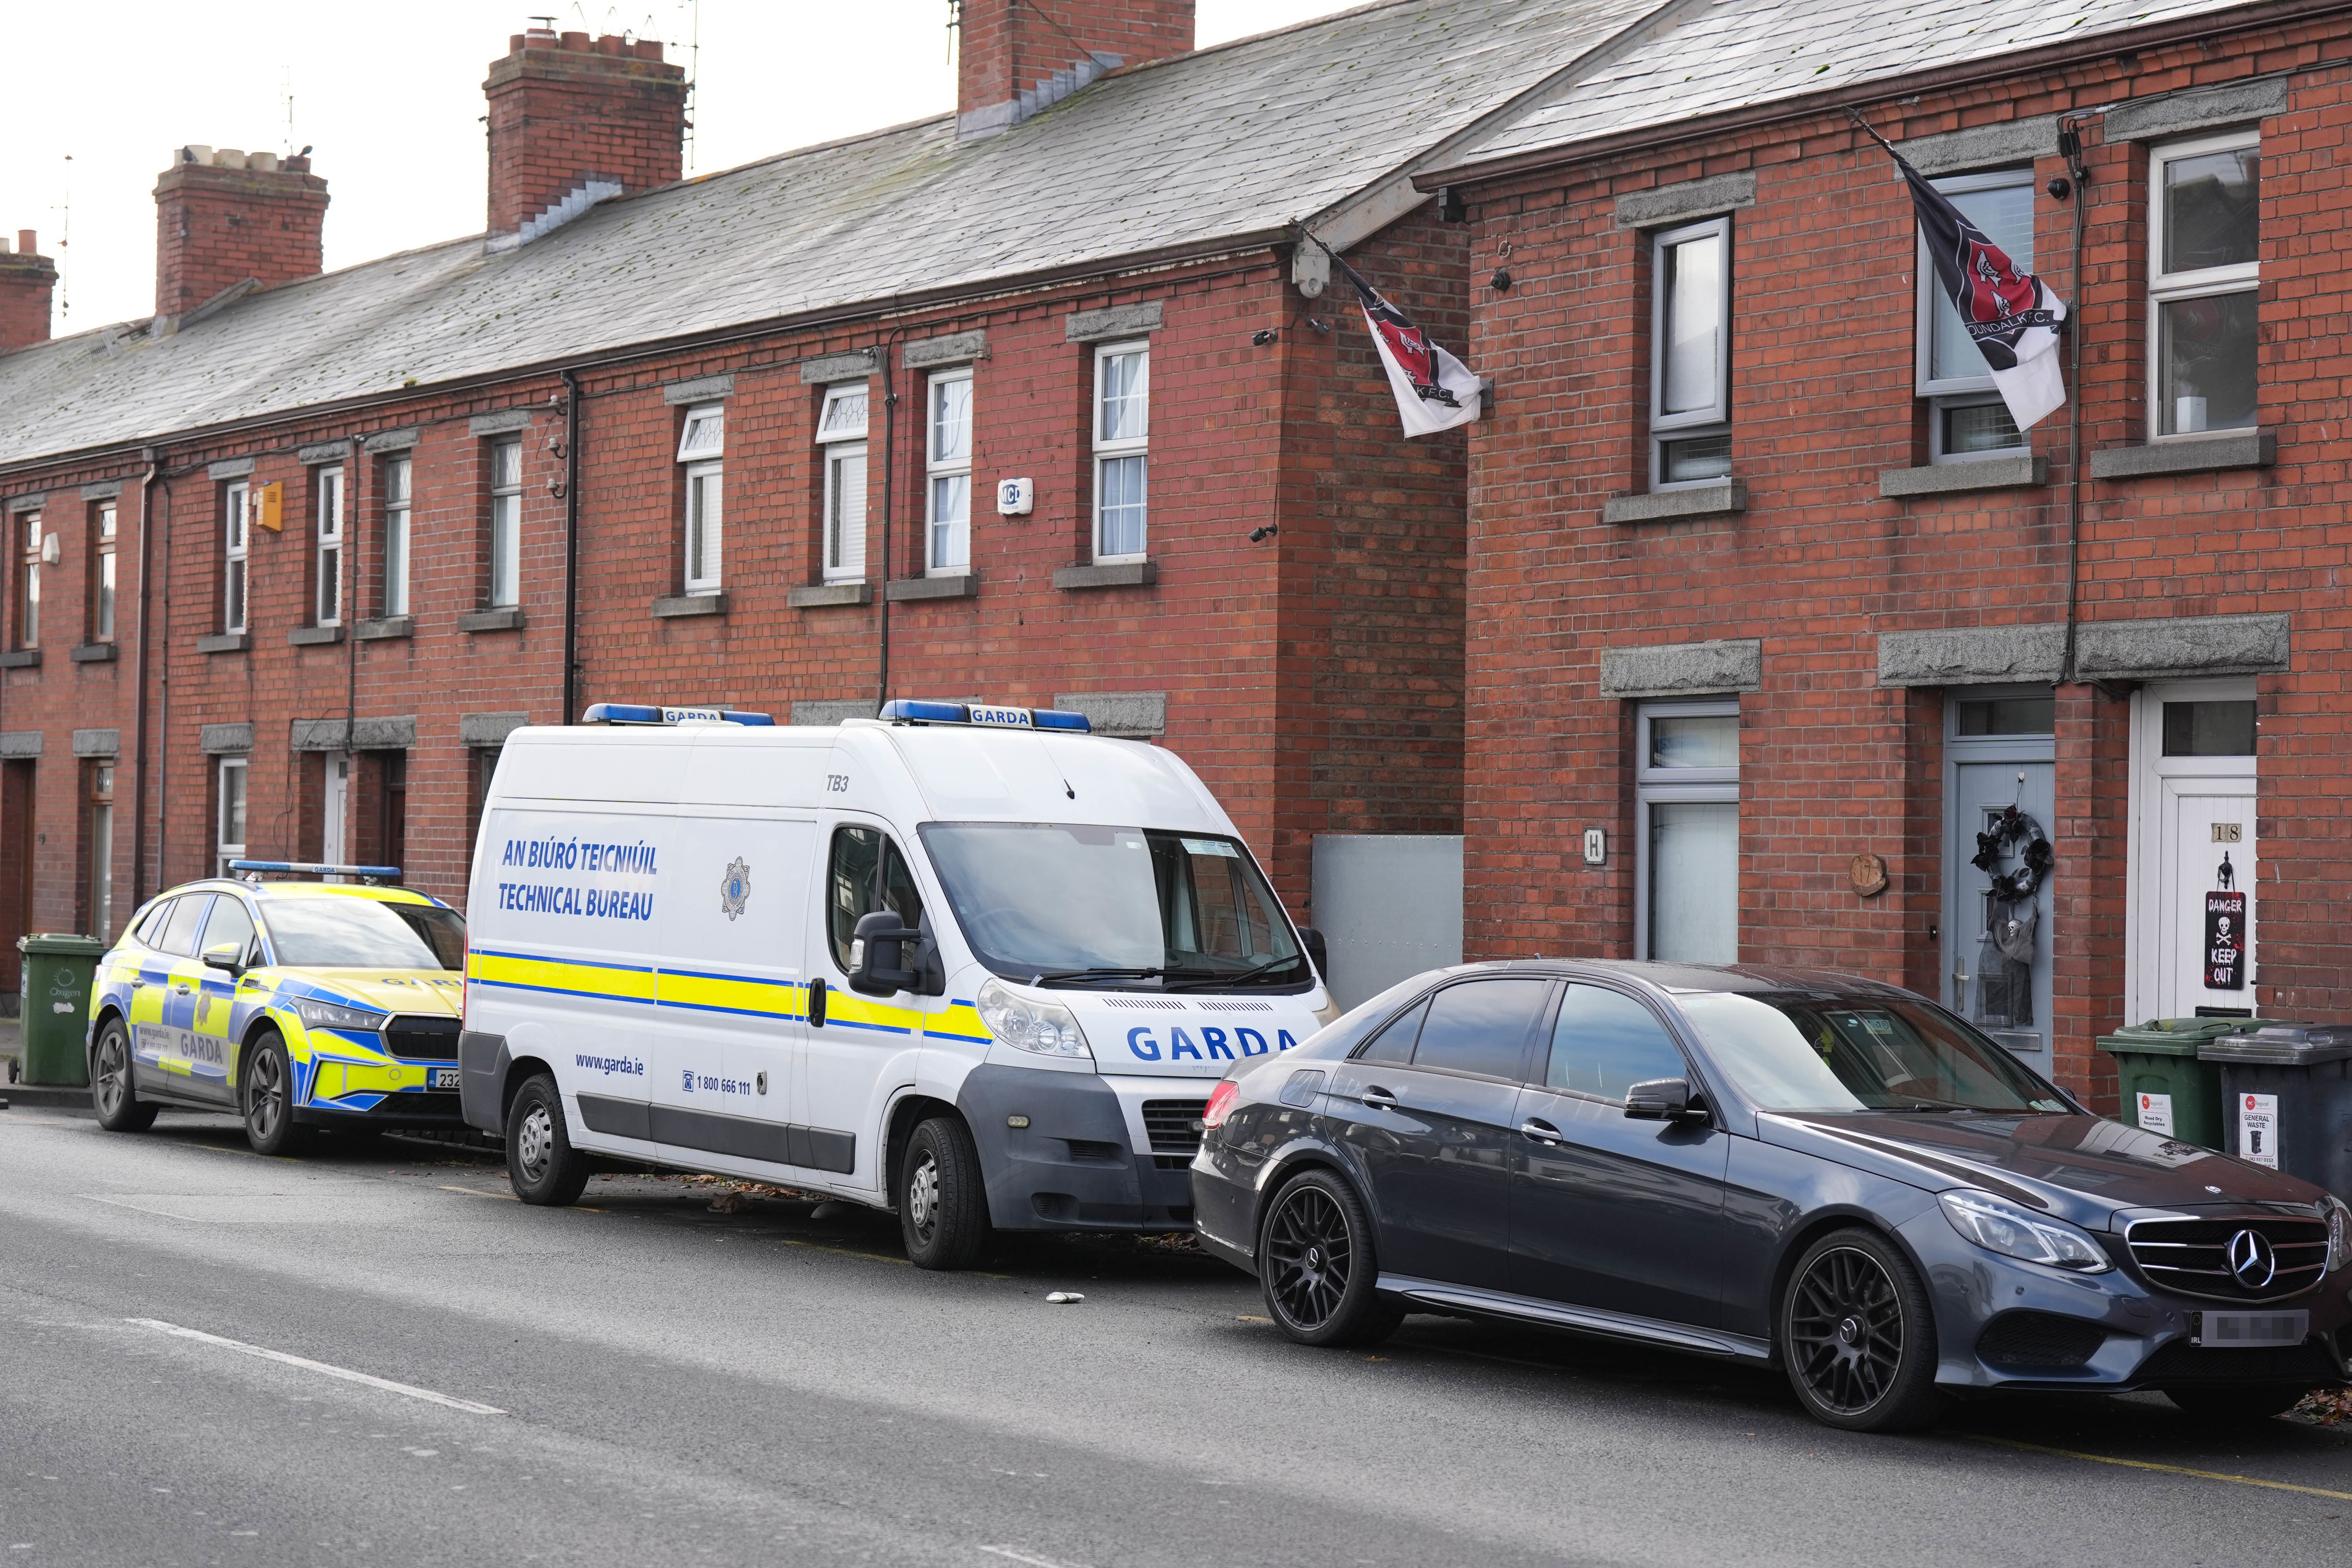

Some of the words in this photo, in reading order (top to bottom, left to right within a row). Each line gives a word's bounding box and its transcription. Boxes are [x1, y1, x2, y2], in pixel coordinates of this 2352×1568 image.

[1967, 313, 2027, 335] DUNDALK
[1428, 388, 1449, 399] F.C.
[999, 487, 1021, 502] MCD
[666, 711, 717, 721] GARDA
[973, 710, 1029, 724] GARDA
[827, 775, 849, 792] TB3
[2216, 826, 2239, 840] 18
[1590, 835, 1598, 857] H
[502, 840, 526, 866] AN
[528, 836, 577, 870] BIÚRÓ
[581, 840, 657, 875] TEICNIÚIL
[499, 883, 582, 915] TECHNICAL
[586, 889, 653, 921] BUREAU
[2209, 899, 2242, 913] DANGER
[2211, 948, 2237, 964] KEEP
[2214, 967, 2233, 984] OUT
[50, 987, 80, 999] Oxigen
[140, 1027, 169, 1039] www.garda.ie
[181, 1034, 223, 1064] GARDA
[1127, 1027, 1298, 1061] GARDA
[576, 1054, 643, 1075] www.garda.ie
[439, 1074, 460, 1087] 232
[697, 1076, 701, 1088] 1
[704, 1077, 718, 1091] 800
[721, 1079, 736, 1093] 666
[738, 1082, 750, 1095] 111
